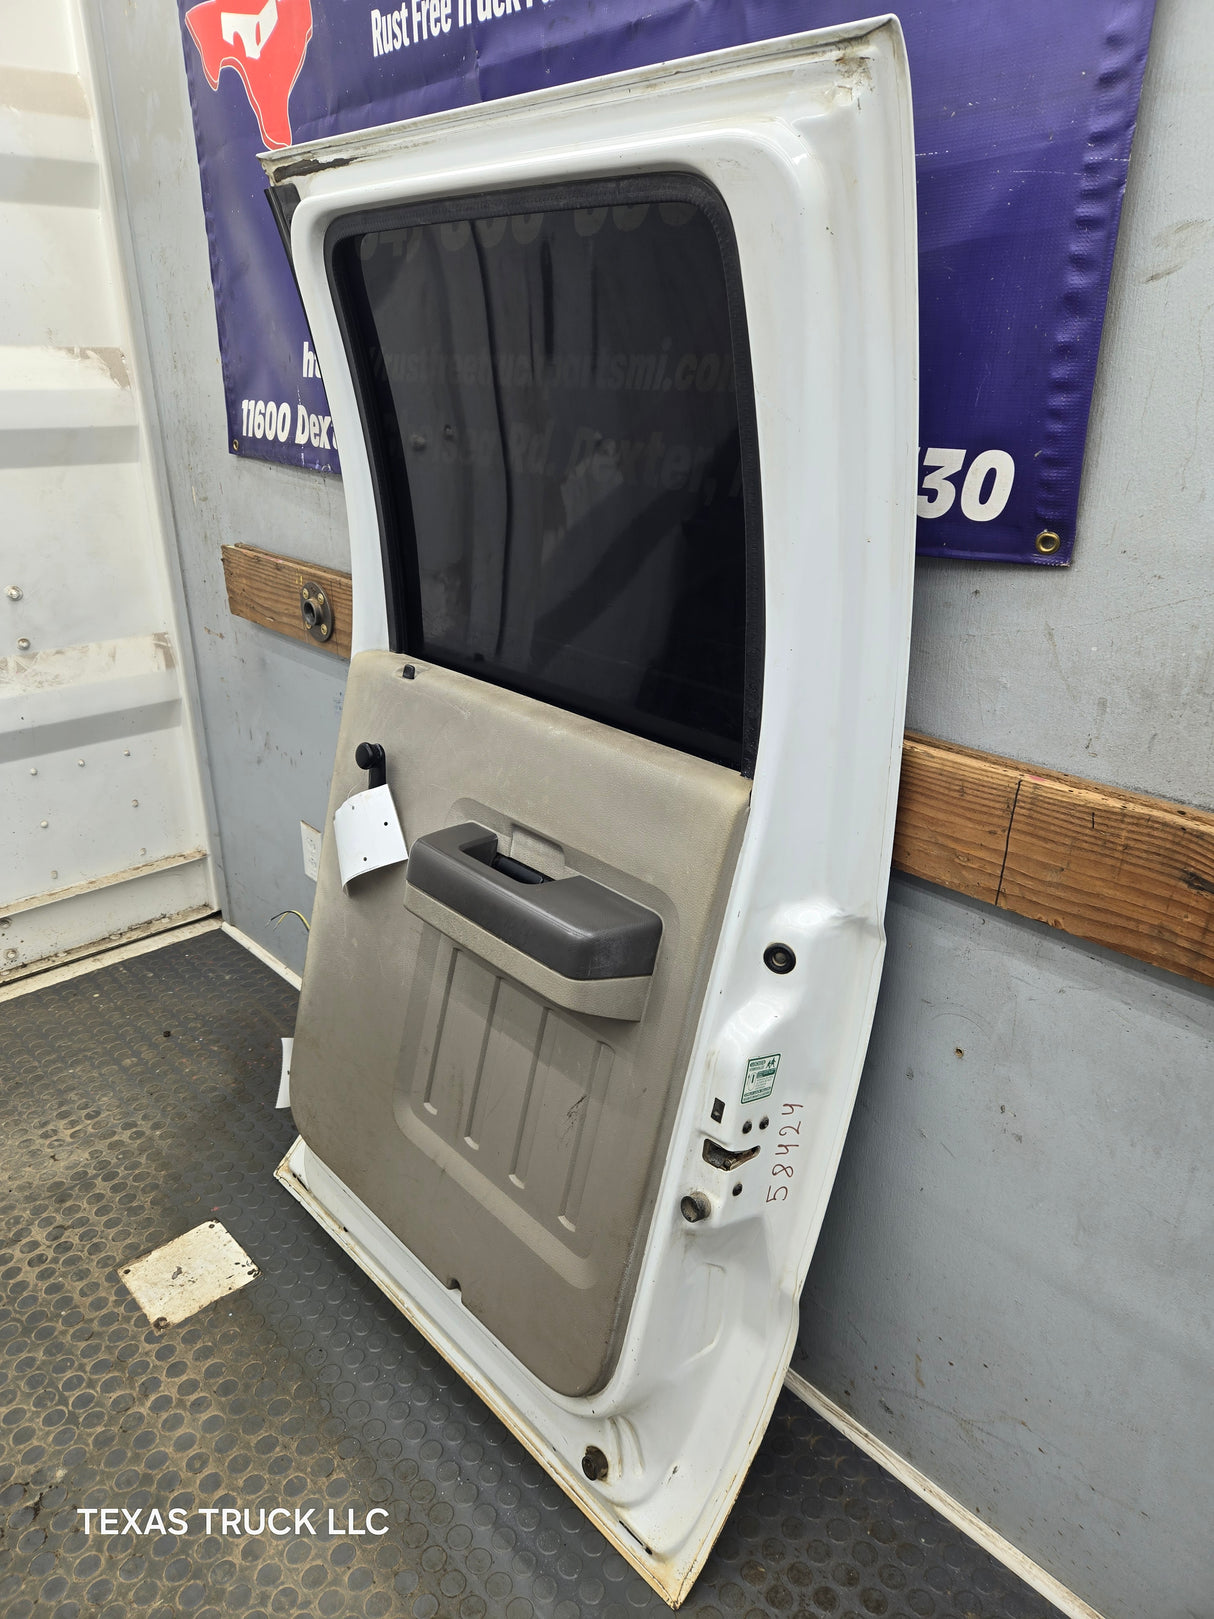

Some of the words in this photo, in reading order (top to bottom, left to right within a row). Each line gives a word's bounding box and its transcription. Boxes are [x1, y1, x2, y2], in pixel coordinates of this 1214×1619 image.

[370, 2, 410, 57] Rust
[412, 0, 452, 43] Free
[241, 399, 291, 442] 11600
[917, 447, 1015, 522] 30
[766, 1103, 804, 1203] 58424
